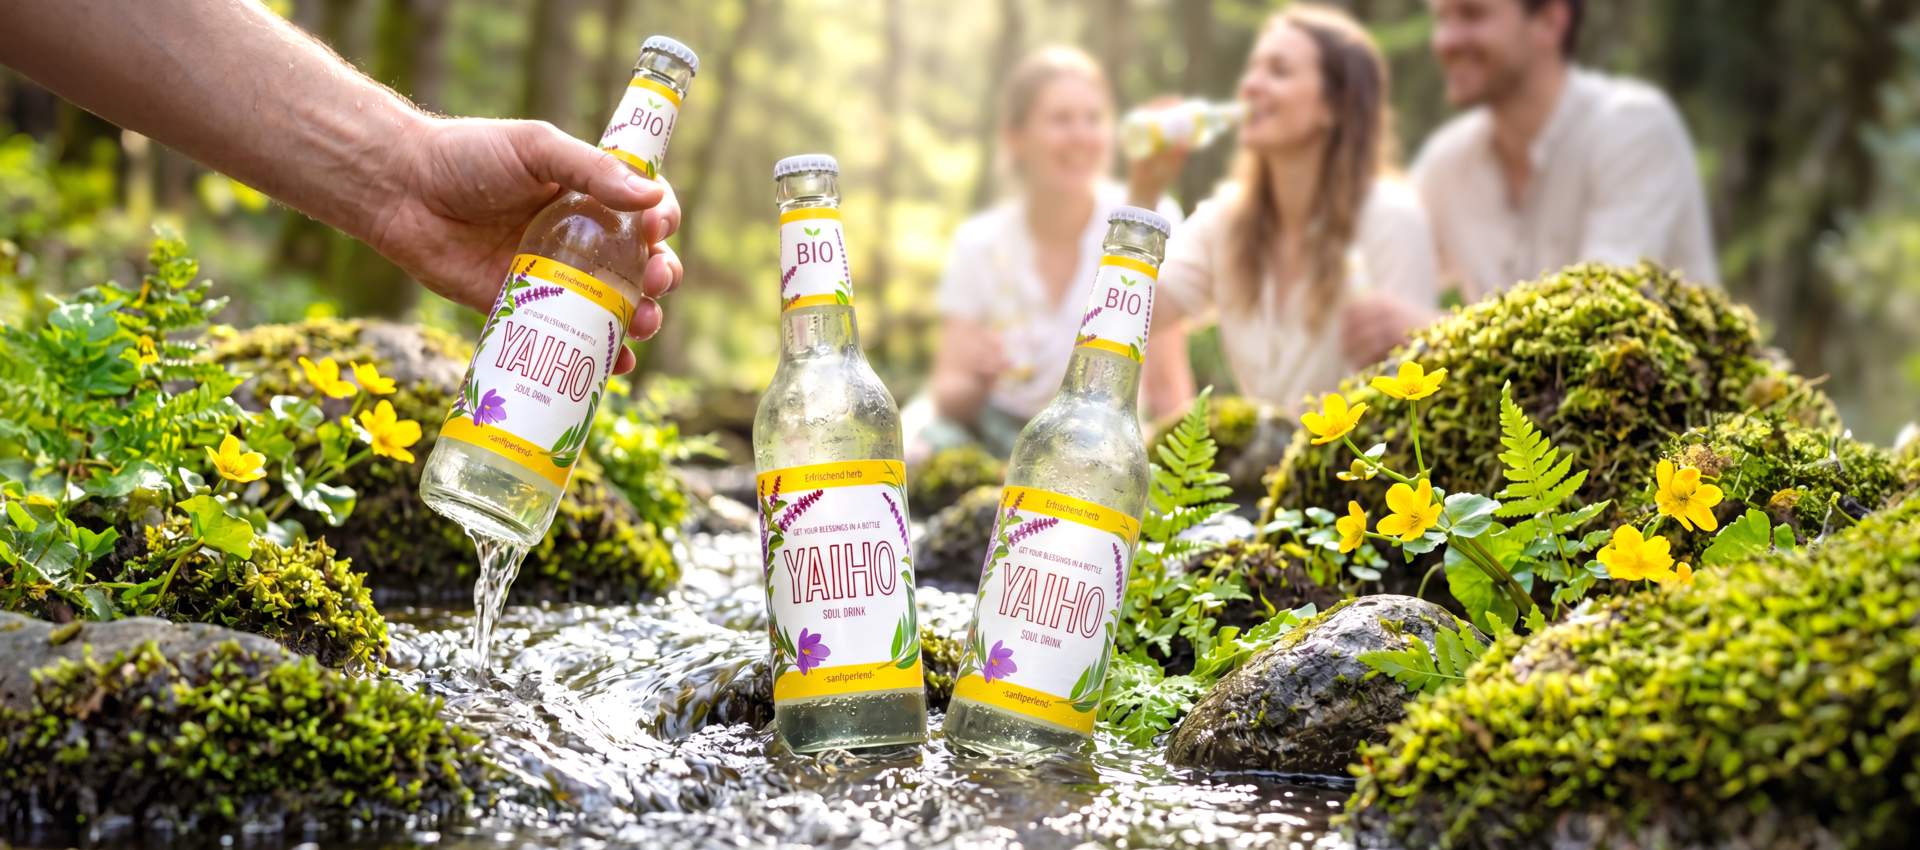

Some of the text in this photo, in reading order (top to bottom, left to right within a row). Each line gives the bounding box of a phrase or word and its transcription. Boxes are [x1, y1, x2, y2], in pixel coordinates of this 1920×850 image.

[630, 107, 663, 136] BIO
[797, 241, 833, 264] BIO
[1105, 287, 1141, 315] BIO
[495, 320, 595, 402] YAIHO
[514, 383, 552, 408] SOUL DRINK
[804, 470, 863, 483] Erfrischend herb
[793, 528, 802, 536] GET
[804, 526, 818, 535] YOUR
[819, 524, 849, 533] BLESSINGS
[862, 520, 881, 529] BOTTLE
[1084, 510, 1100, 521] herb
[783, 540, 896, 604] YAIHO
[1018, 546, 1028, 554] GET
[1029, 548, 1042, 557] YOUR
[1043, 551, 1072, 565] BLESSINGS
[1072, 559, 1079, 567] IN
[1084, 563, 1103, 575] BOTTLE
[822, 606, 866, 620] SOUL DRINK
[998, 562, 1105, 639] YAIHO
[1020, 629, 1062, 649] SOUL DRINK
